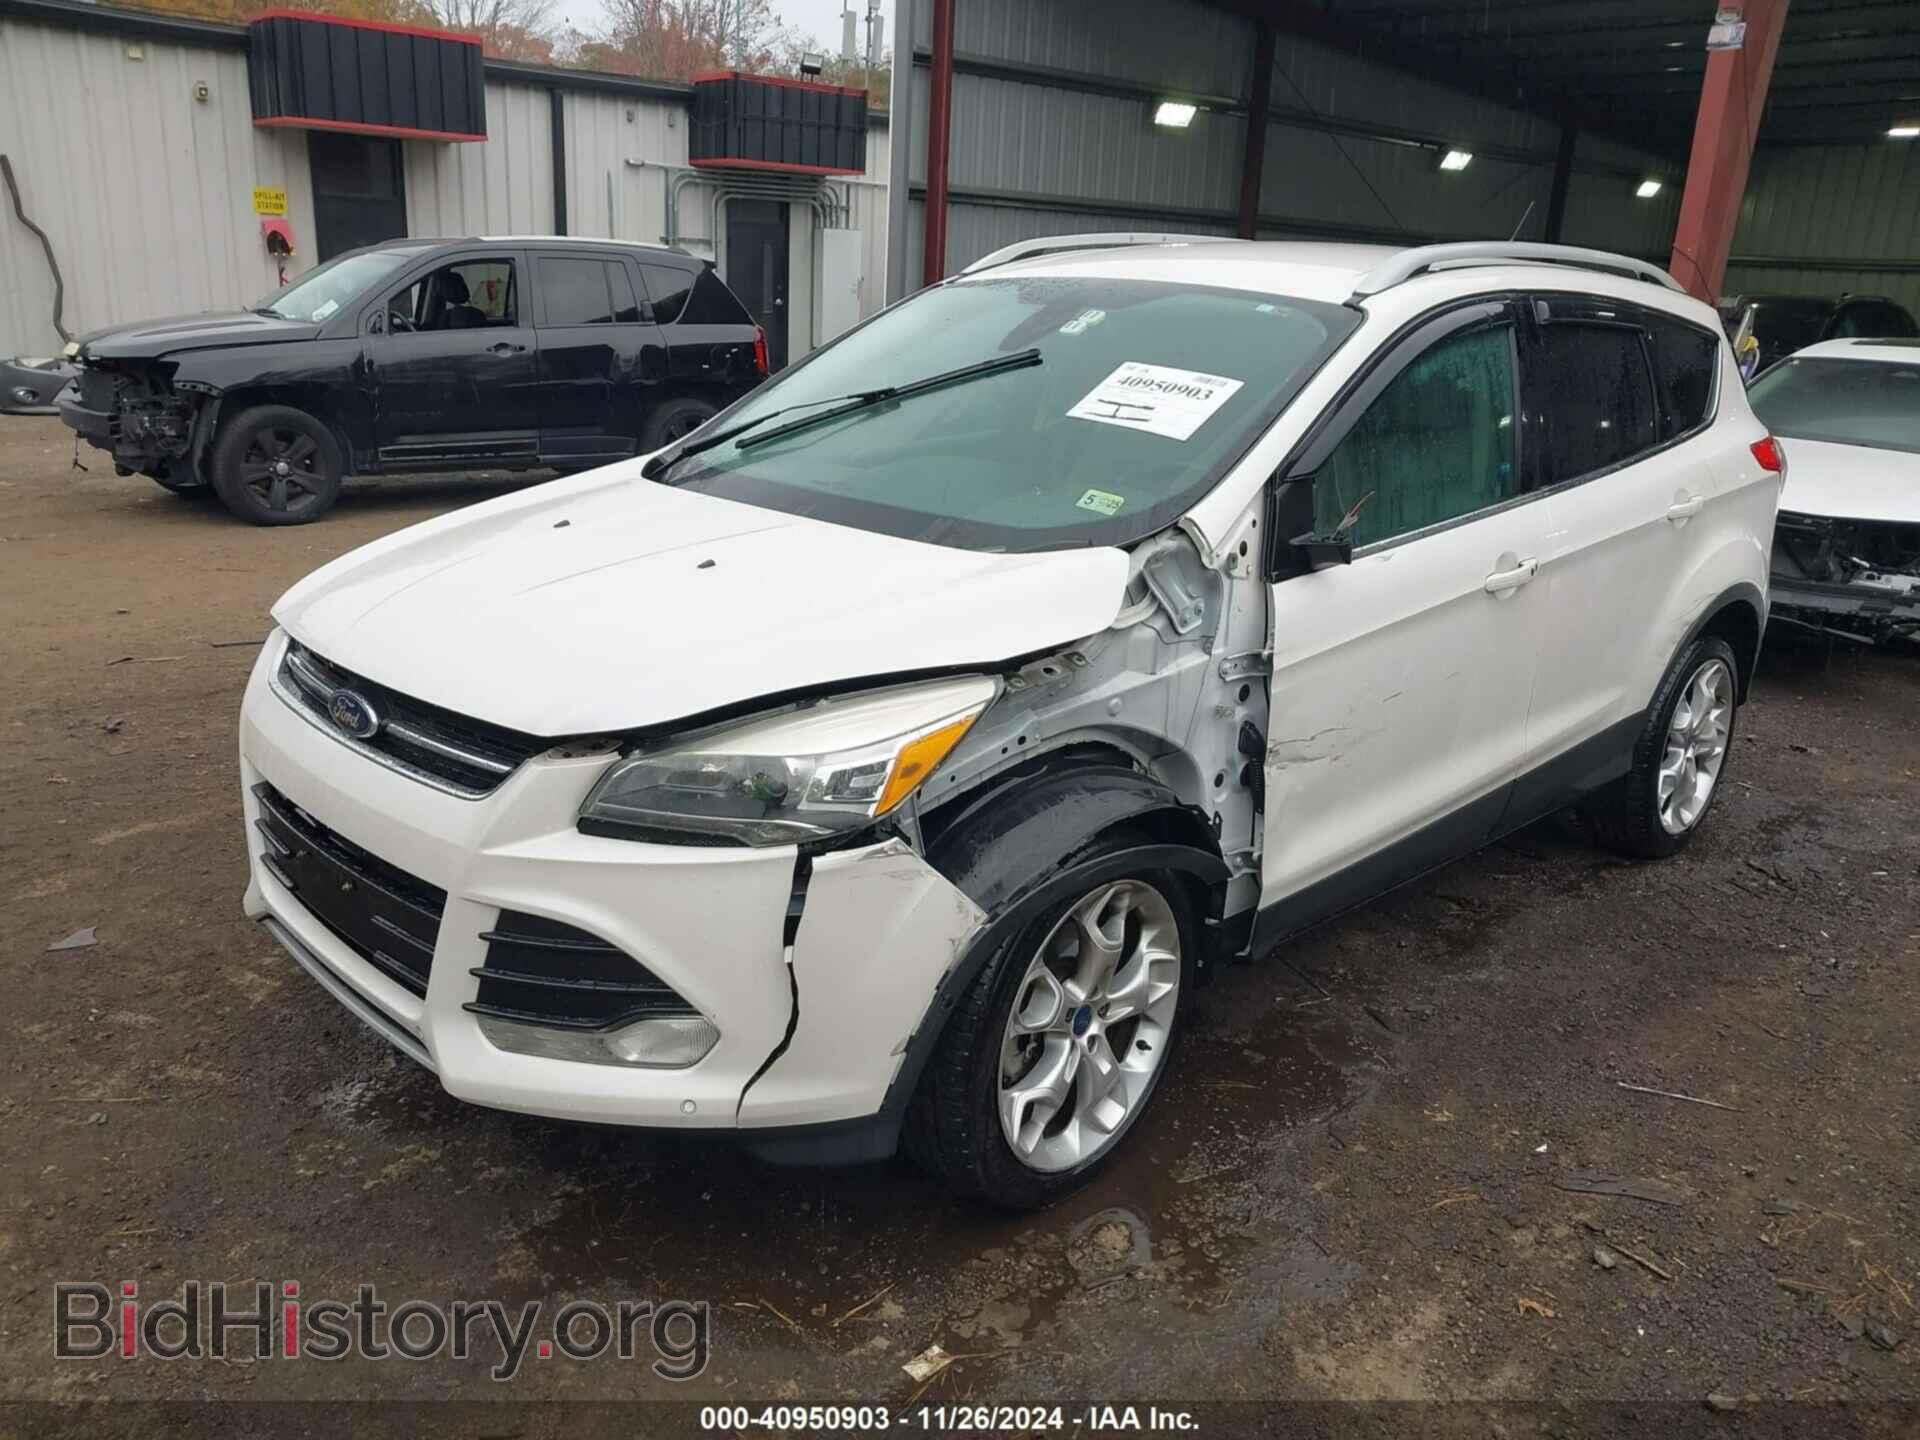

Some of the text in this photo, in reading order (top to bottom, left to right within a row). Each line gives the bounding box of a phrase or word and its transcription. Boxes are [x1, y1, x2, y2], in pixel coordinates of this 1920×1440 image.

[1117, 375, 1214, 401] 40950903
[1084, 494, 1097, 505] 5
[334, 696, 360, 729] Ford
